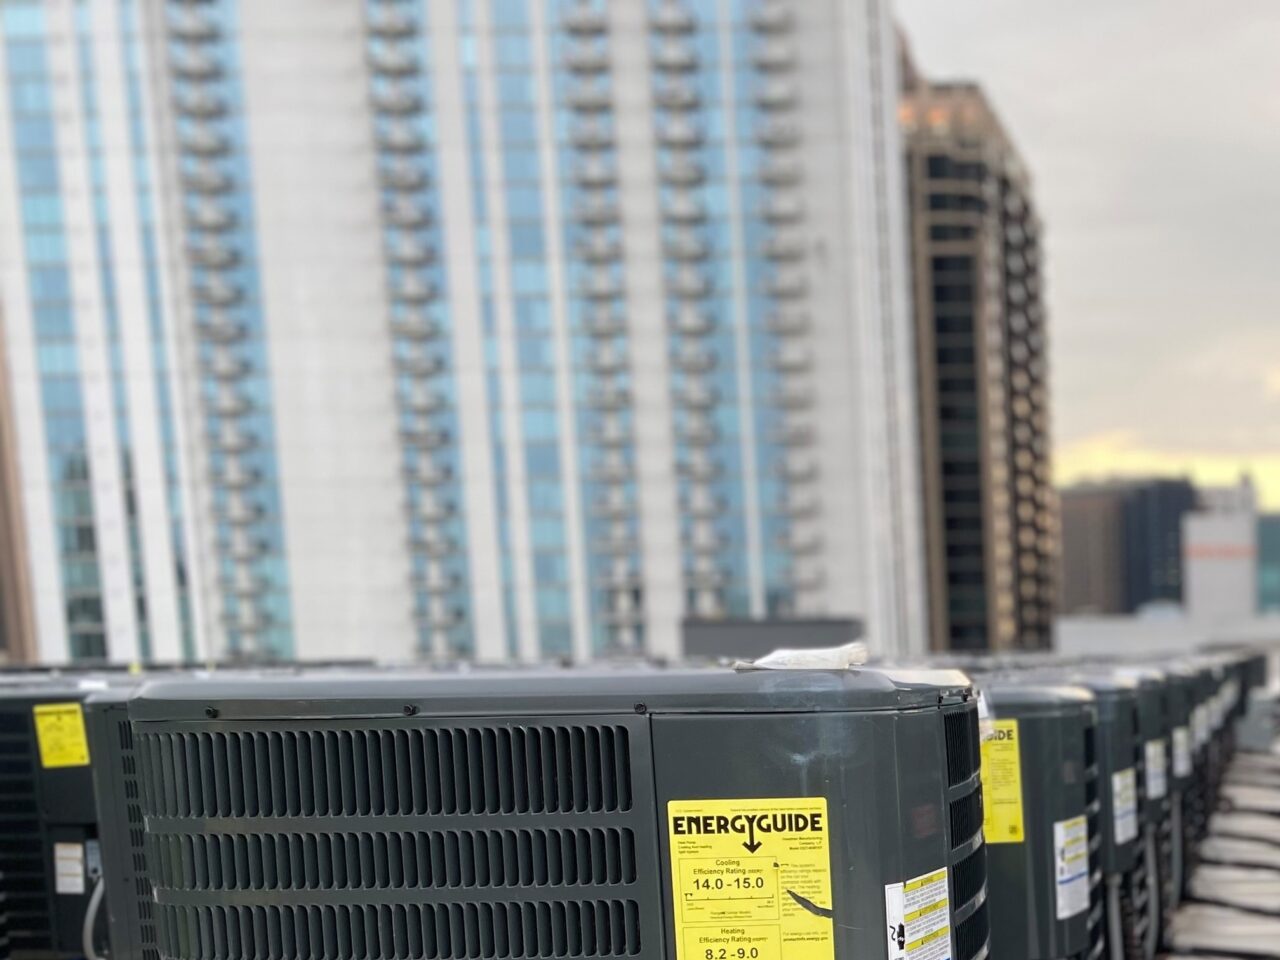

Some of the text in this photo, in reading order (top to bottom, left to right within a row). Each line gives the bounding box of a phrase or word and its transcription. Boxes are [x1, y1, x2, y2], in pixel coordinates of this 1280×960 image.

[673, 812, 823, 835] ENERGYGUIDE
[716, 859, 740, 867] Cooling
[725, 867, 746, 875] Rating
